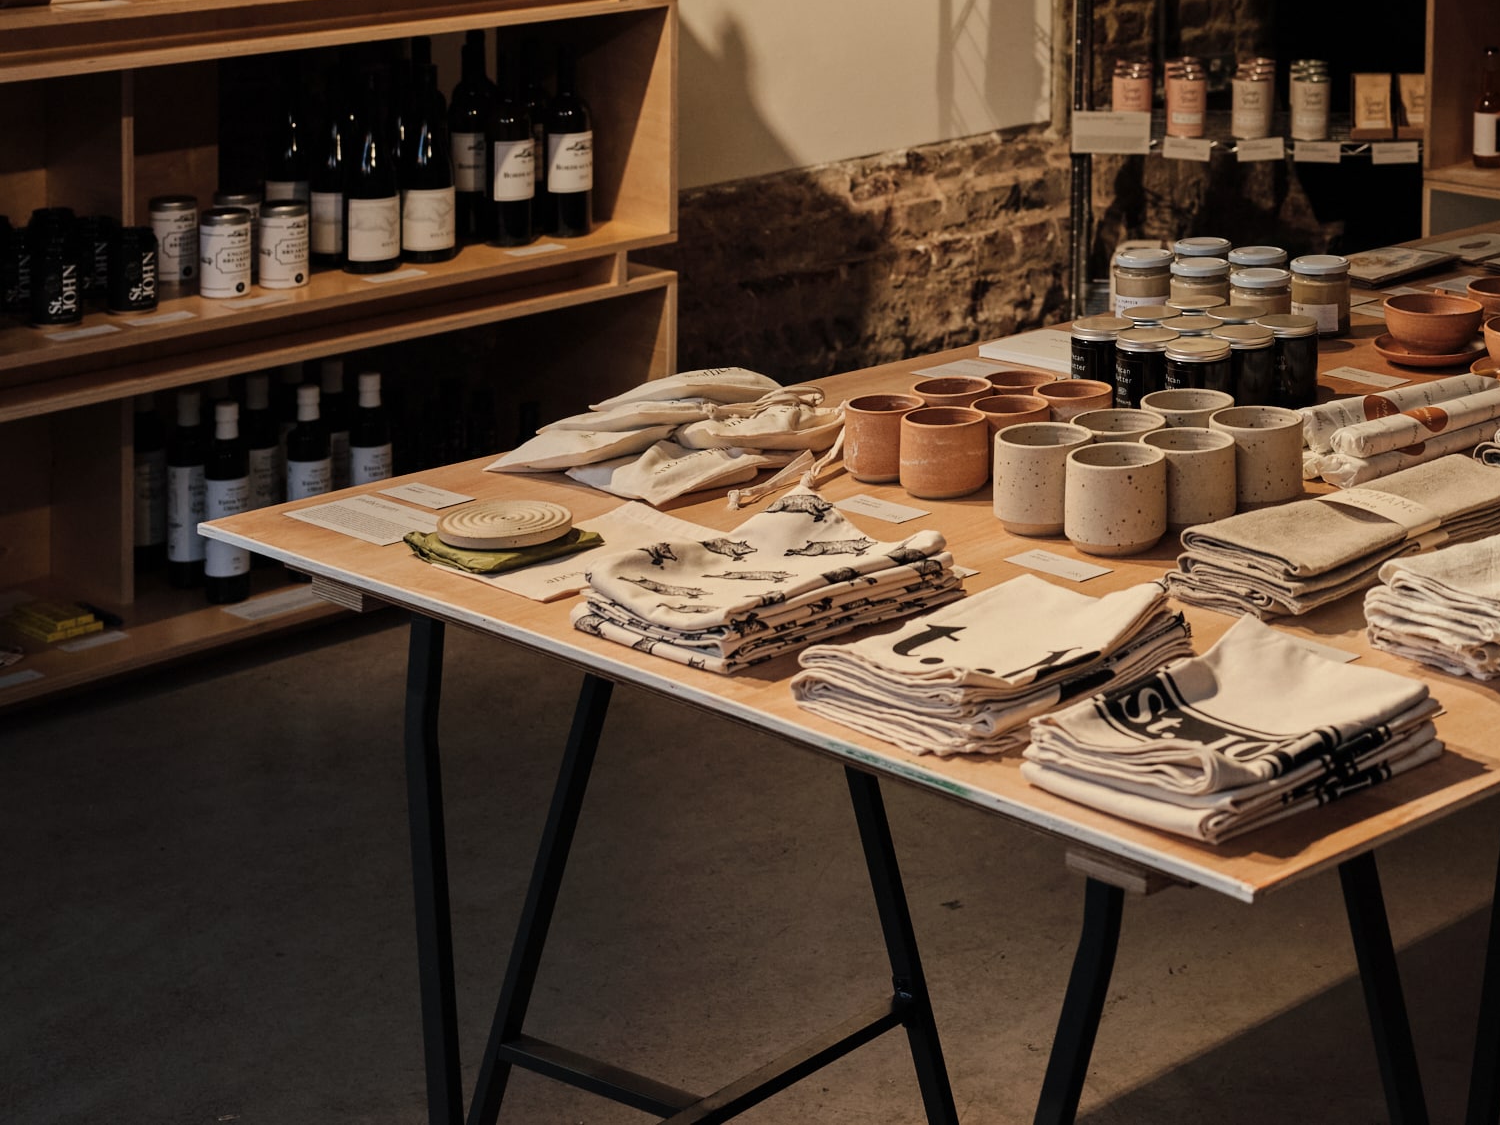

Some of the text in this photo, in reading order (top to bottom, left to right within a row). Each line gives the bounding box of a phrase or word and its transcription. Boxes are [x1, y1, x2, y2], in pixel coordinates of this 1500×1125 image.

[62, 264, 77, 312] JOHN
[142, 251, 155, 298] JOHN
[1118, 687, 1184, 740] St.
